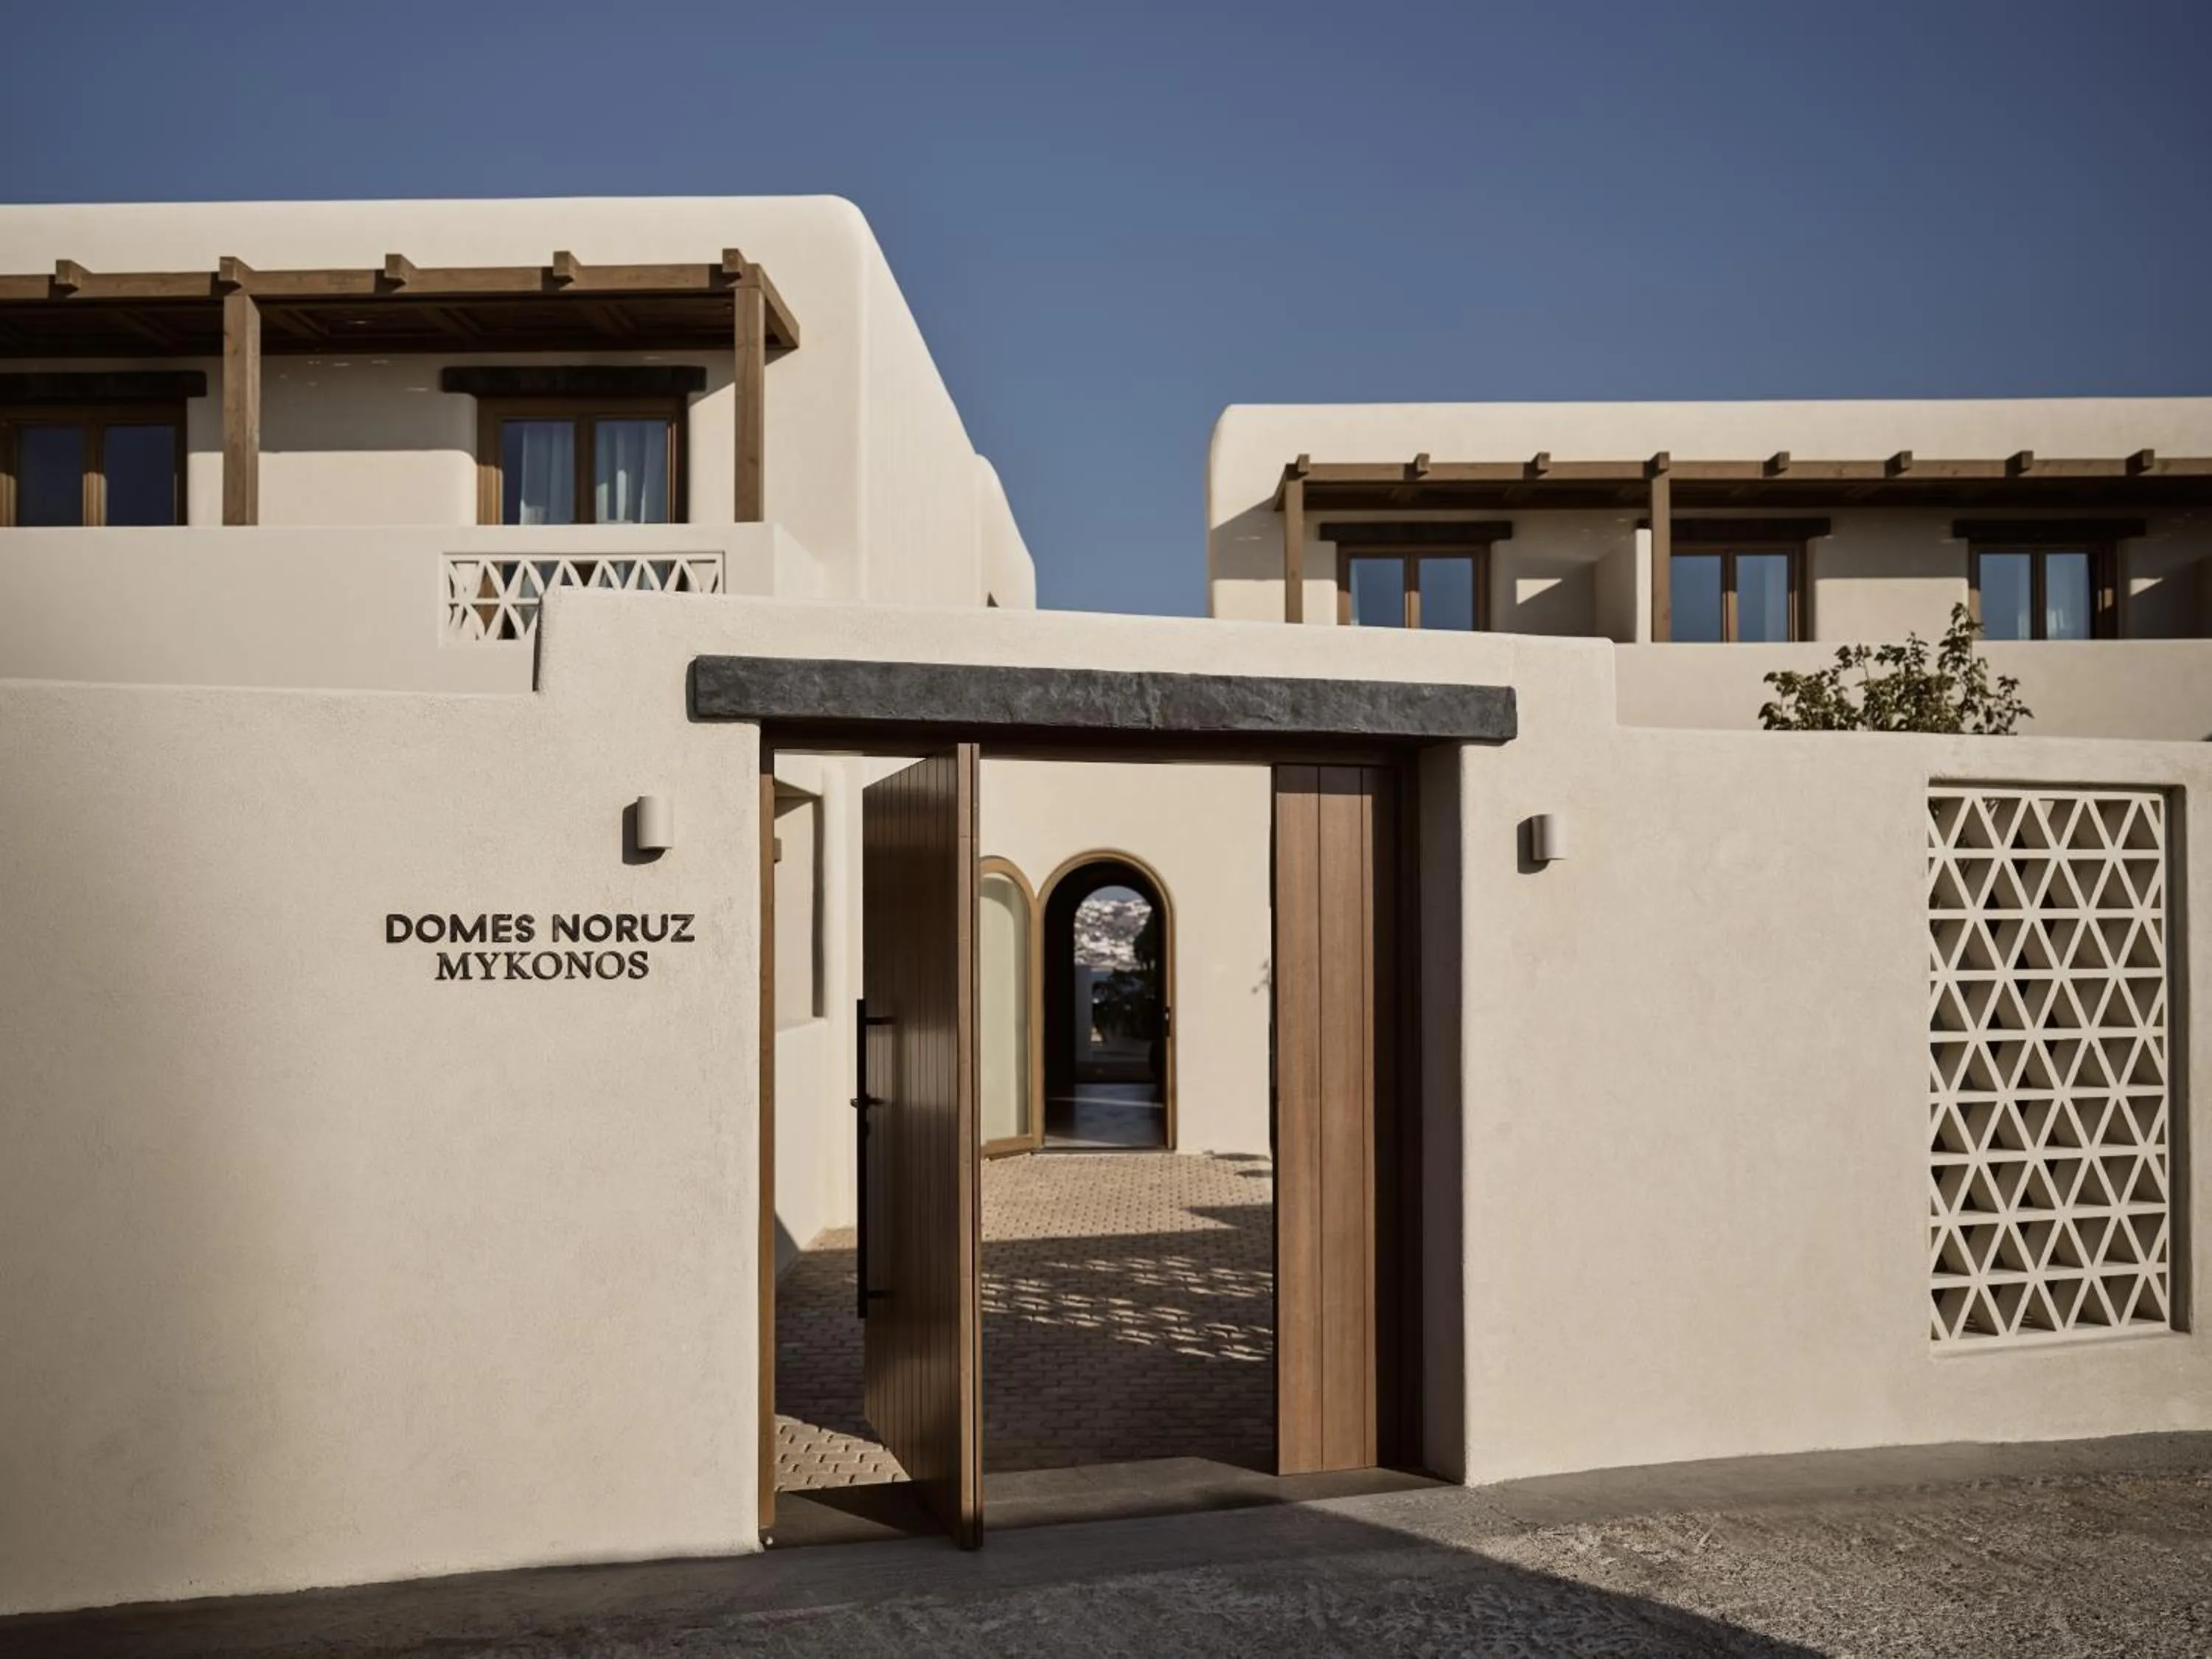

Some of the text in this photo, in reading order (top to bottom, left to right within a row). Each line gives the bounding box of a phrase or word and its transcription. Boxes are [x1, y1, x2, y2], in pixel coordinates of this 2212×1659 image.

[386, 914, 695, 943] DOMES NORUZ
[434, 950, 650, 980] MYKONOS
